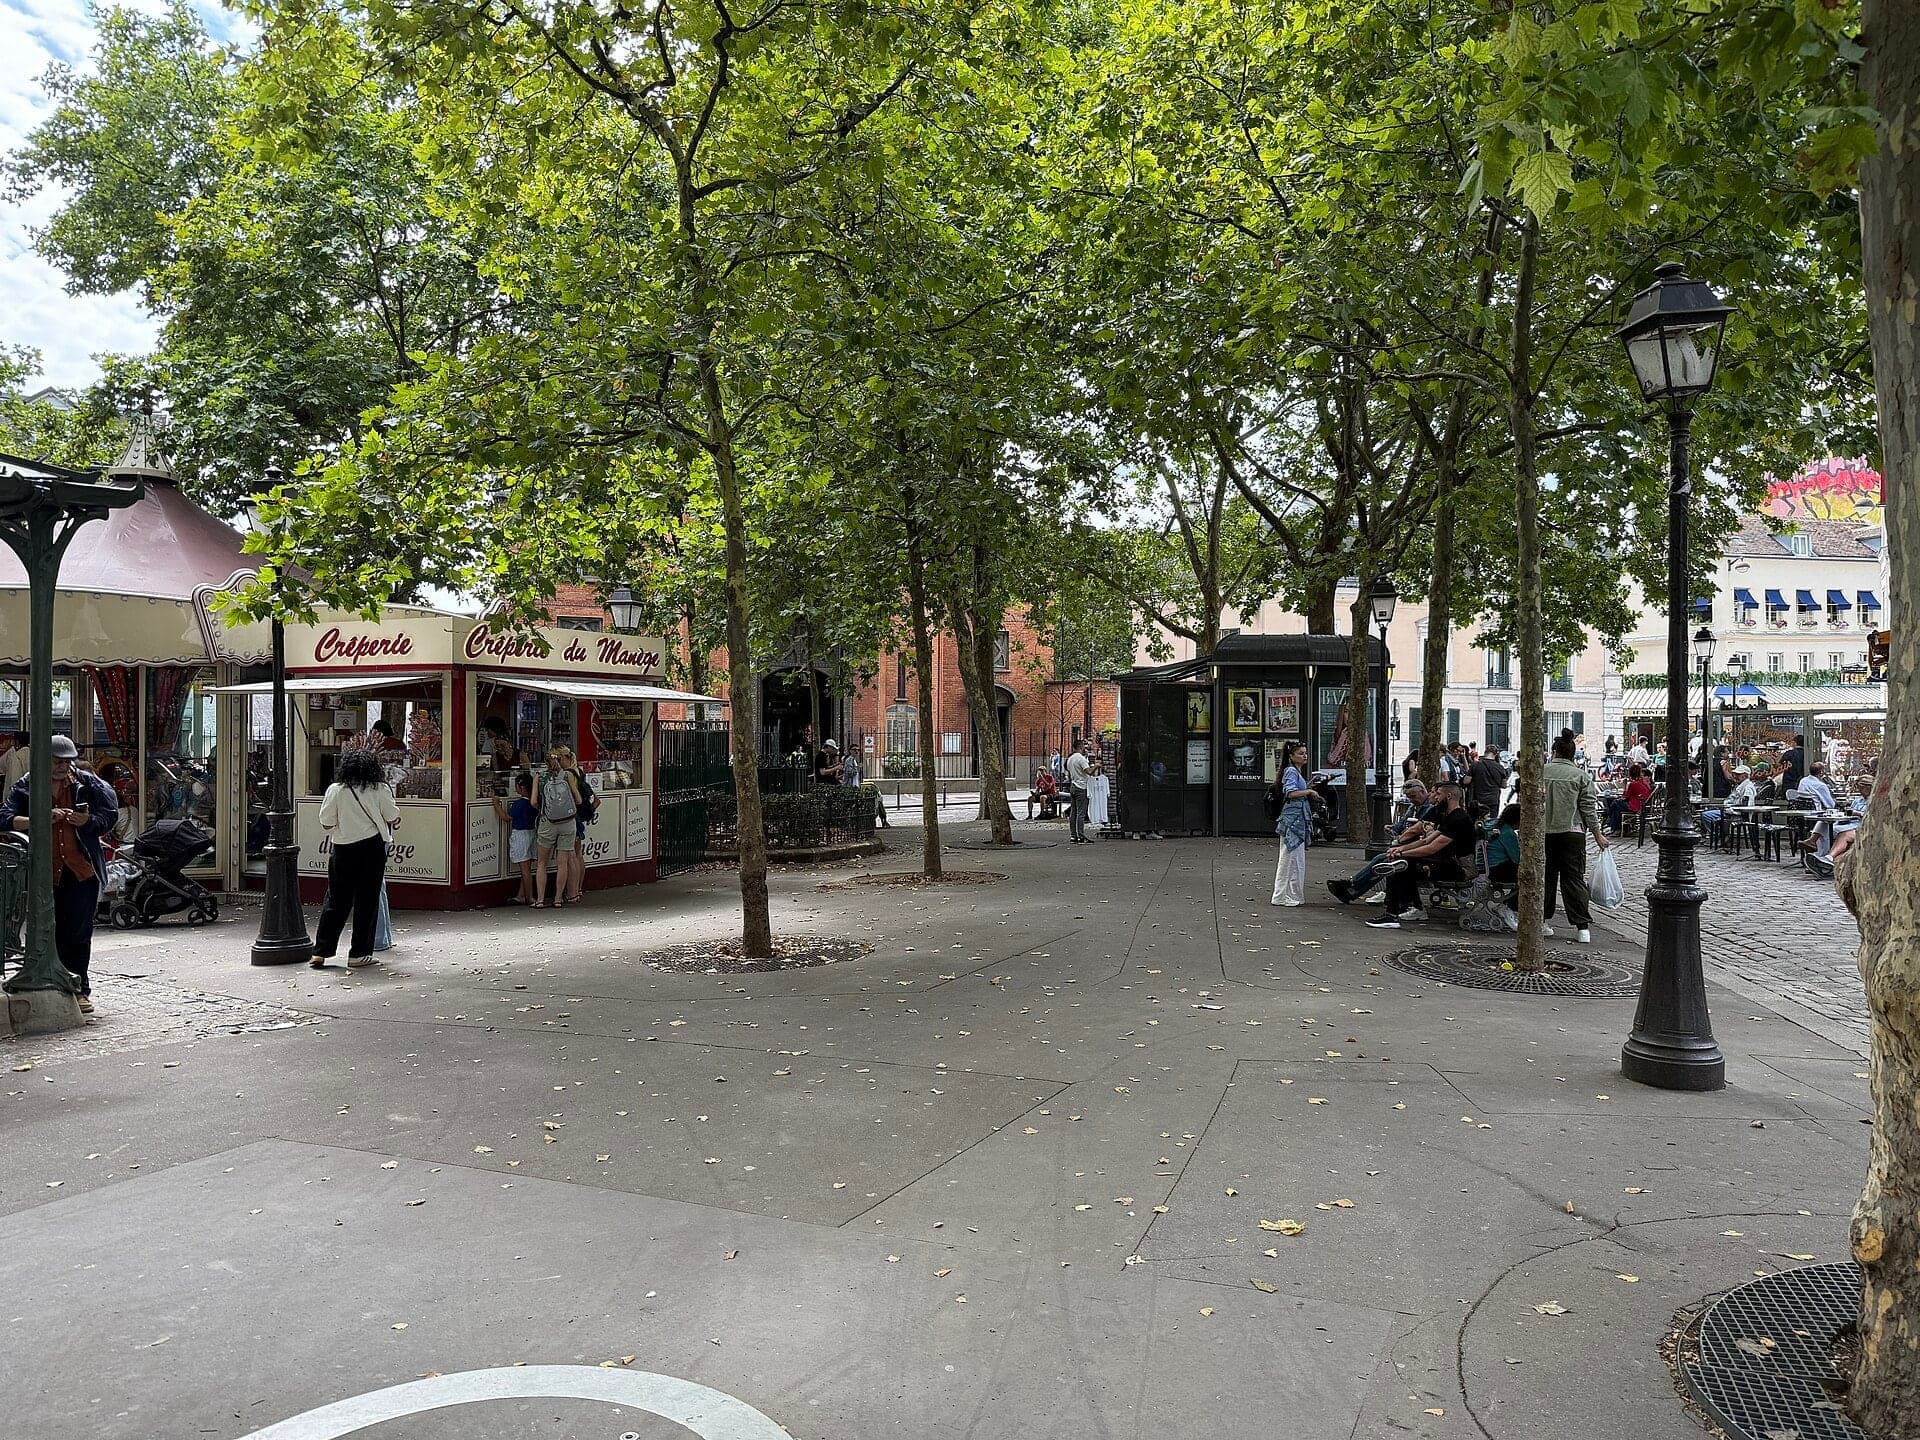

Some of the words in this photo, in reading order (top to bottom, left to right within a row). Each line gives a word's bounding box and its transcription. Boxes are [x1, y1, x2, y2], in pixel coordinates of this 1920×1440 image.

[314, 627, 413, 665] Crêperie
[563, 637, 587, 661] du
[597, 637, 660, 674] Manège
[398, 866, 433, 874] BOISSONS
